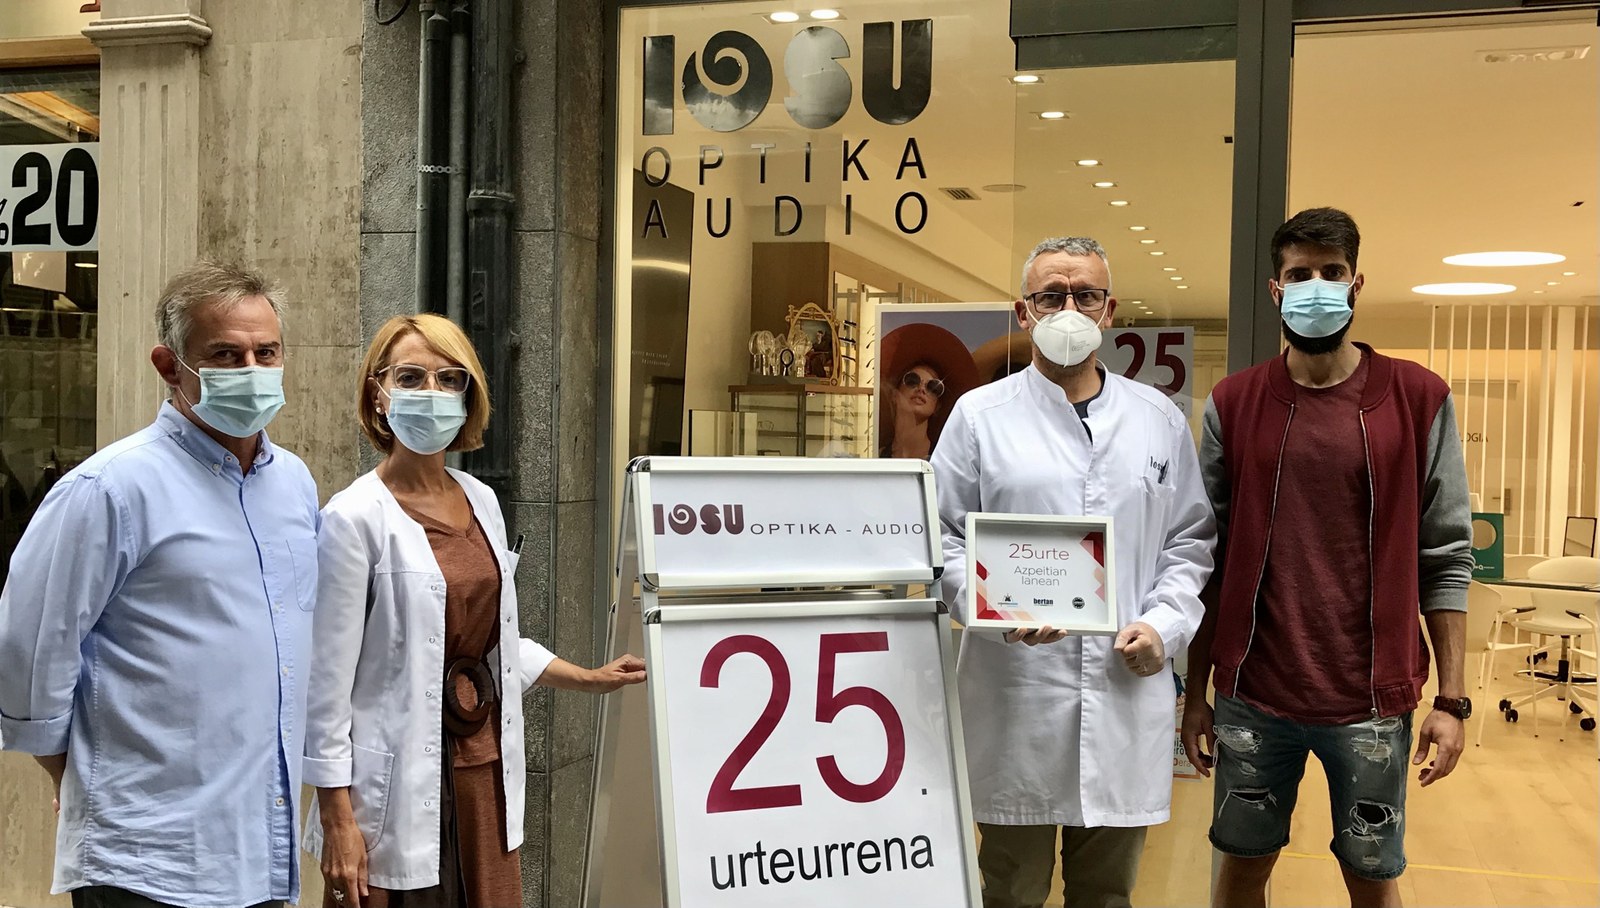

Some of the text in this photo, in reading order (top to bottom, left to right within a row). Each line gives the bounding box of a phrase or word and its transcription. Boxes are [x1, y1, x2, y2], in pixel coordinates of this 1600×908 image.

[643, 18, 933, 136] IOSU
[641, 137, 927, 188] OPTIKA
[641, 191, 929, 240] AUDIO
[652, 503, 745, 536] IOSU
[750, 523, 837, 535] OPTIKA
[862, 523, 924, 535] AUDIO
[1009, 543, 1070, 560] 25urte
[1014, 565, 1067, 577] Azpeitian
[1021, 576, 1060, 586] lanean
[1033, 597, 1054, 605] bertan
[710, 834, 935, 891] urteurrena
